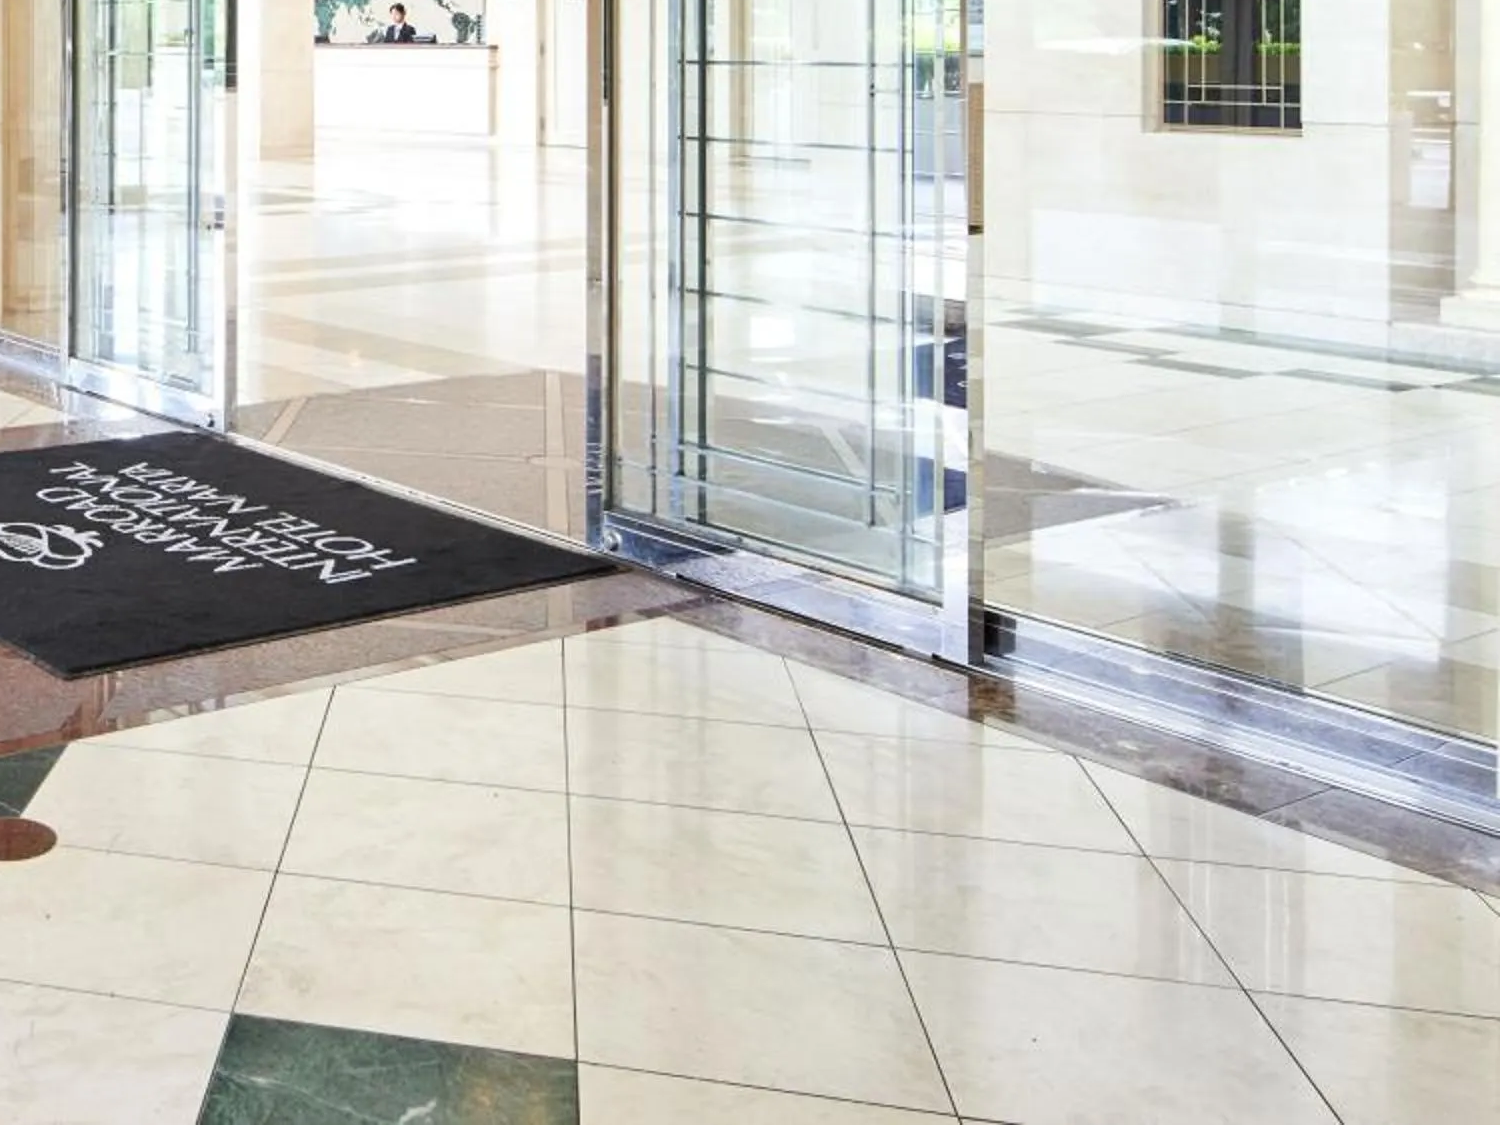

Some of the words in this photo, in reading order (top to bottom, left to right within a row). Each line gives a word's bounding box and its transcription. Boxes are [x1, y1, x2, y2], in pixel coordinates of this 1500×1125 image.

[49, 460, 373, 584] INTERNATIONAL
[117, 461, 269, 514] NARITA
[36, 486, 263, 574] MARROAD
[253, 511, 418, 570] HOTEL
